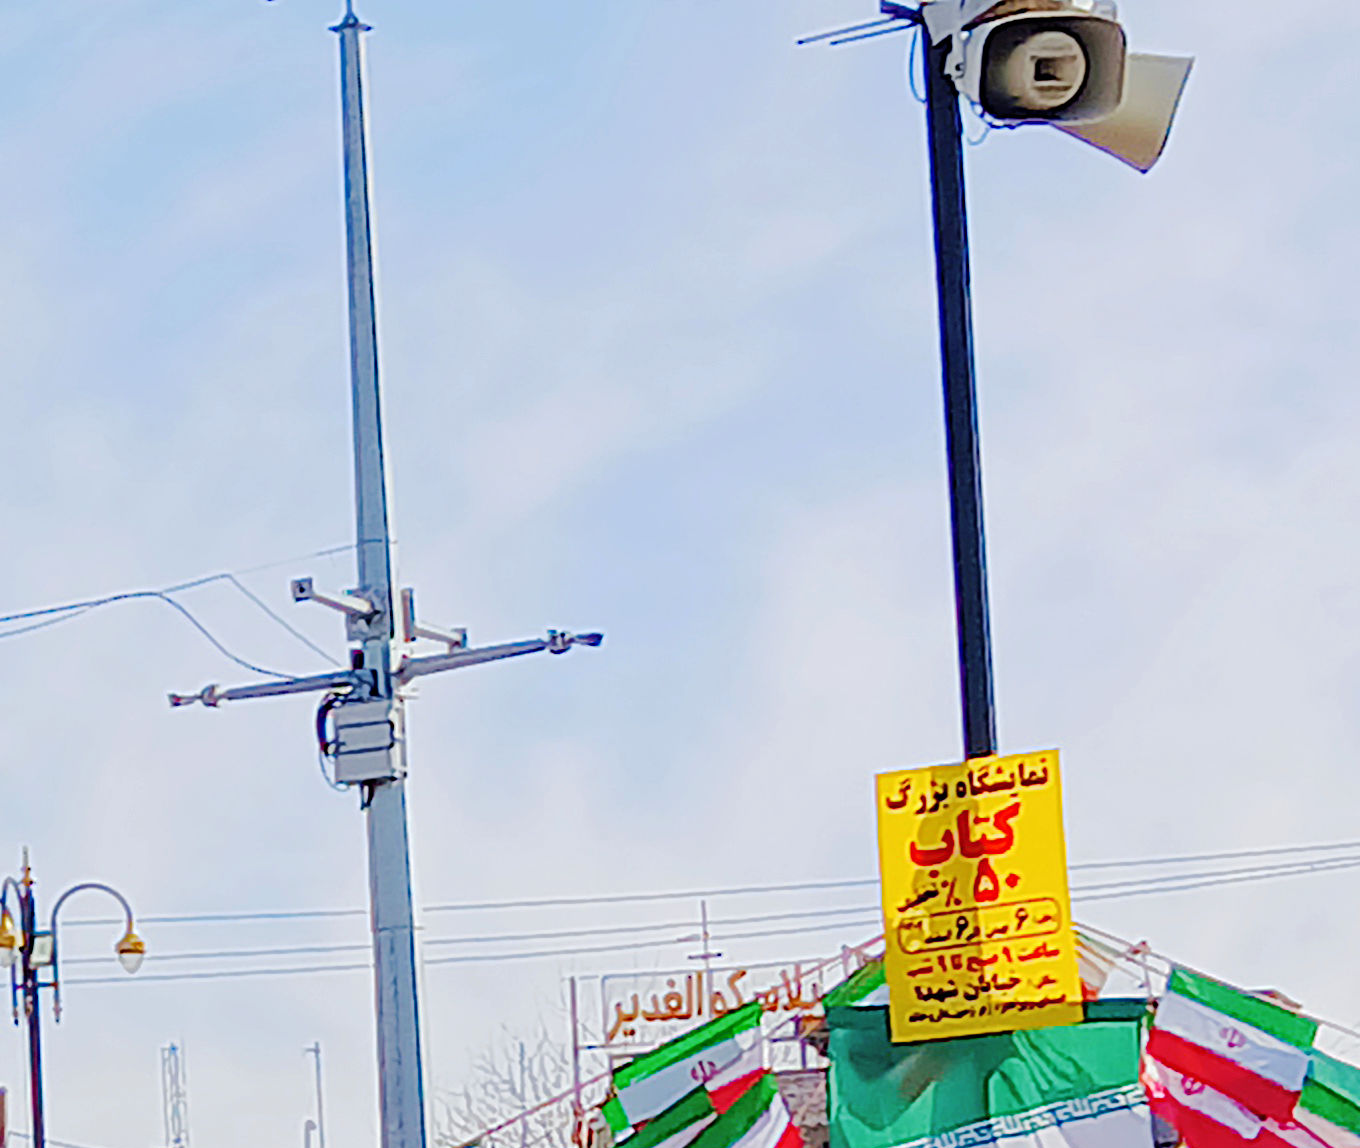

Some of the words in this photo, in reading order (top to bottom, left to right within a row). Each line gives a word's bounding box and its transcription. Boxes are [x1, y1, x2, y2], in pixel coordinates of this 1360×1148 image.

[885, 777, 948, 815] بزرگ
[956, 757, 1048, 799] نمایشگاه
[909, 802, 1021, 879] کتاب
[973, 857, 1021, 903] ۵۰
[606, 970, 704, 1043] الغدیر
